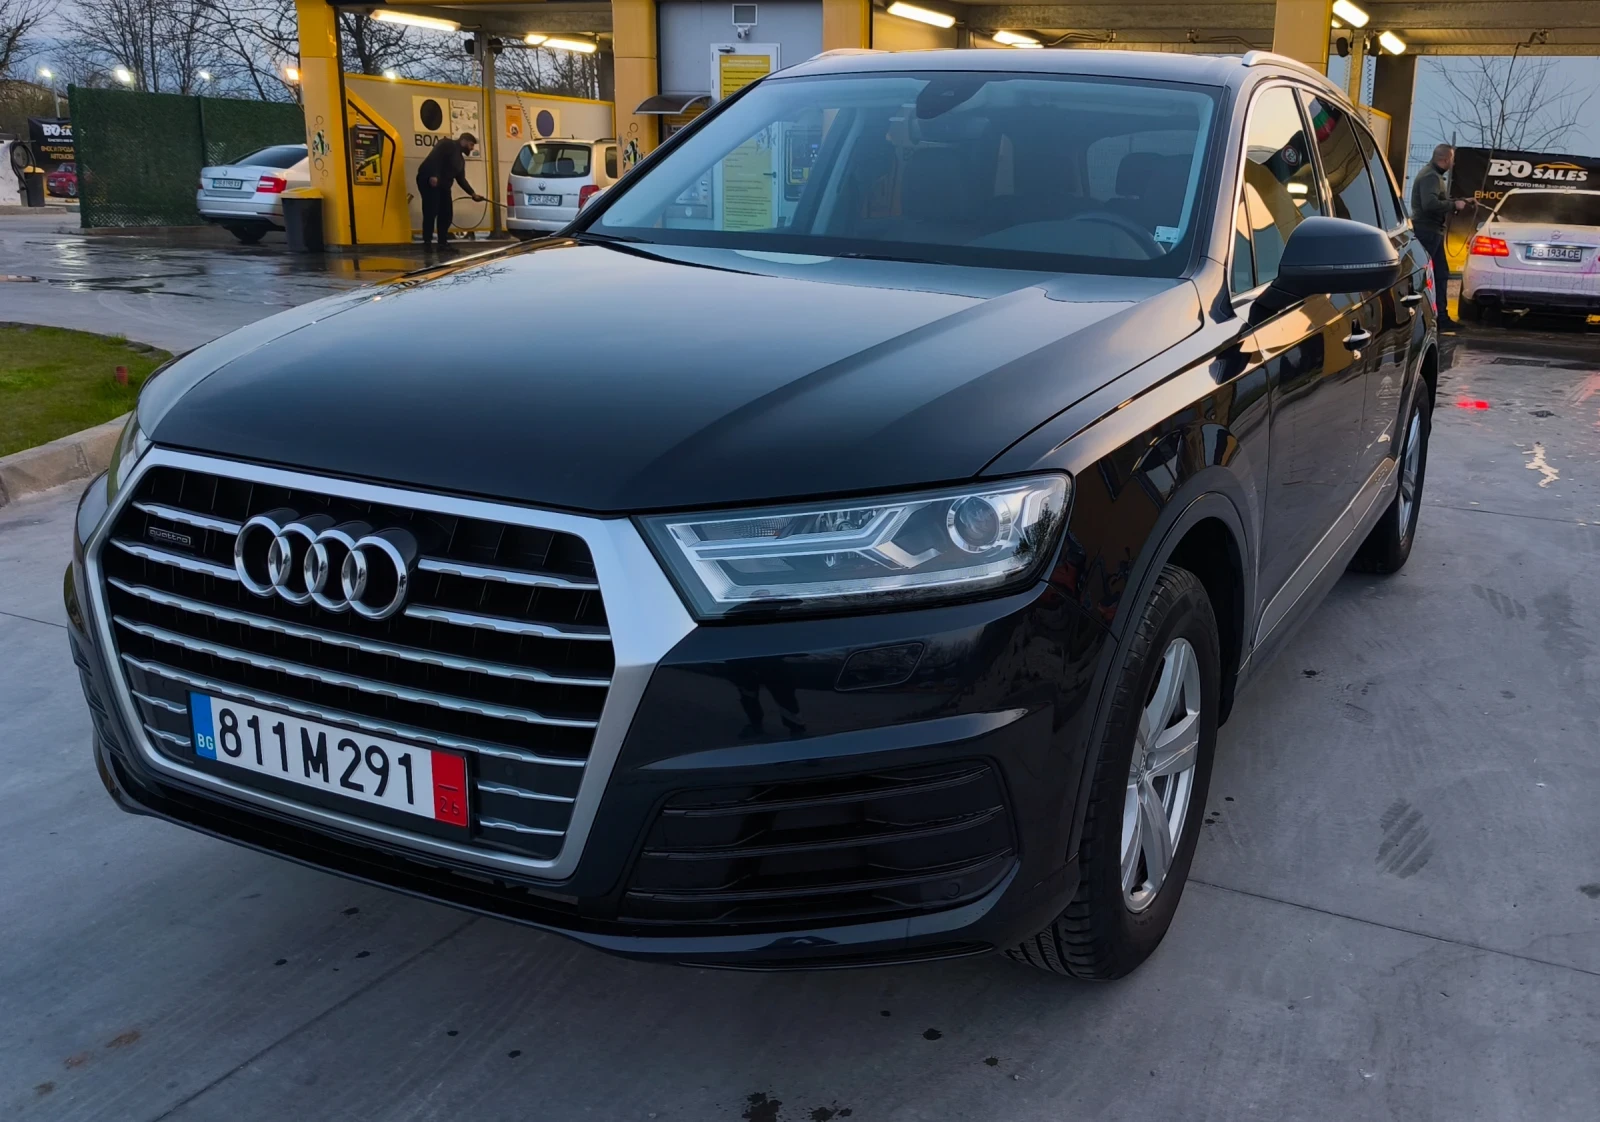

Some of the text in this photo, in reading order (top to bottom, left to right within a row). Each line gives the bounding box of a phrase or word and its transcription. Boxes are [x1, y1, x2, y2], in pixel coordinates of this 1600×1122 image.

[1488, 158, 1589, 181] BO SALES
[1474, 190, 1503, 200] ВНОС
[1546, 249, 1566, 258] 1934
[1567, 250, 1580, 259] CE
[149, 529, 188, 543] quattro
[197, 733, 214, 750] BG
[219, 708, 415, 805] 811M291
[439, 796, 460, 816] 26
